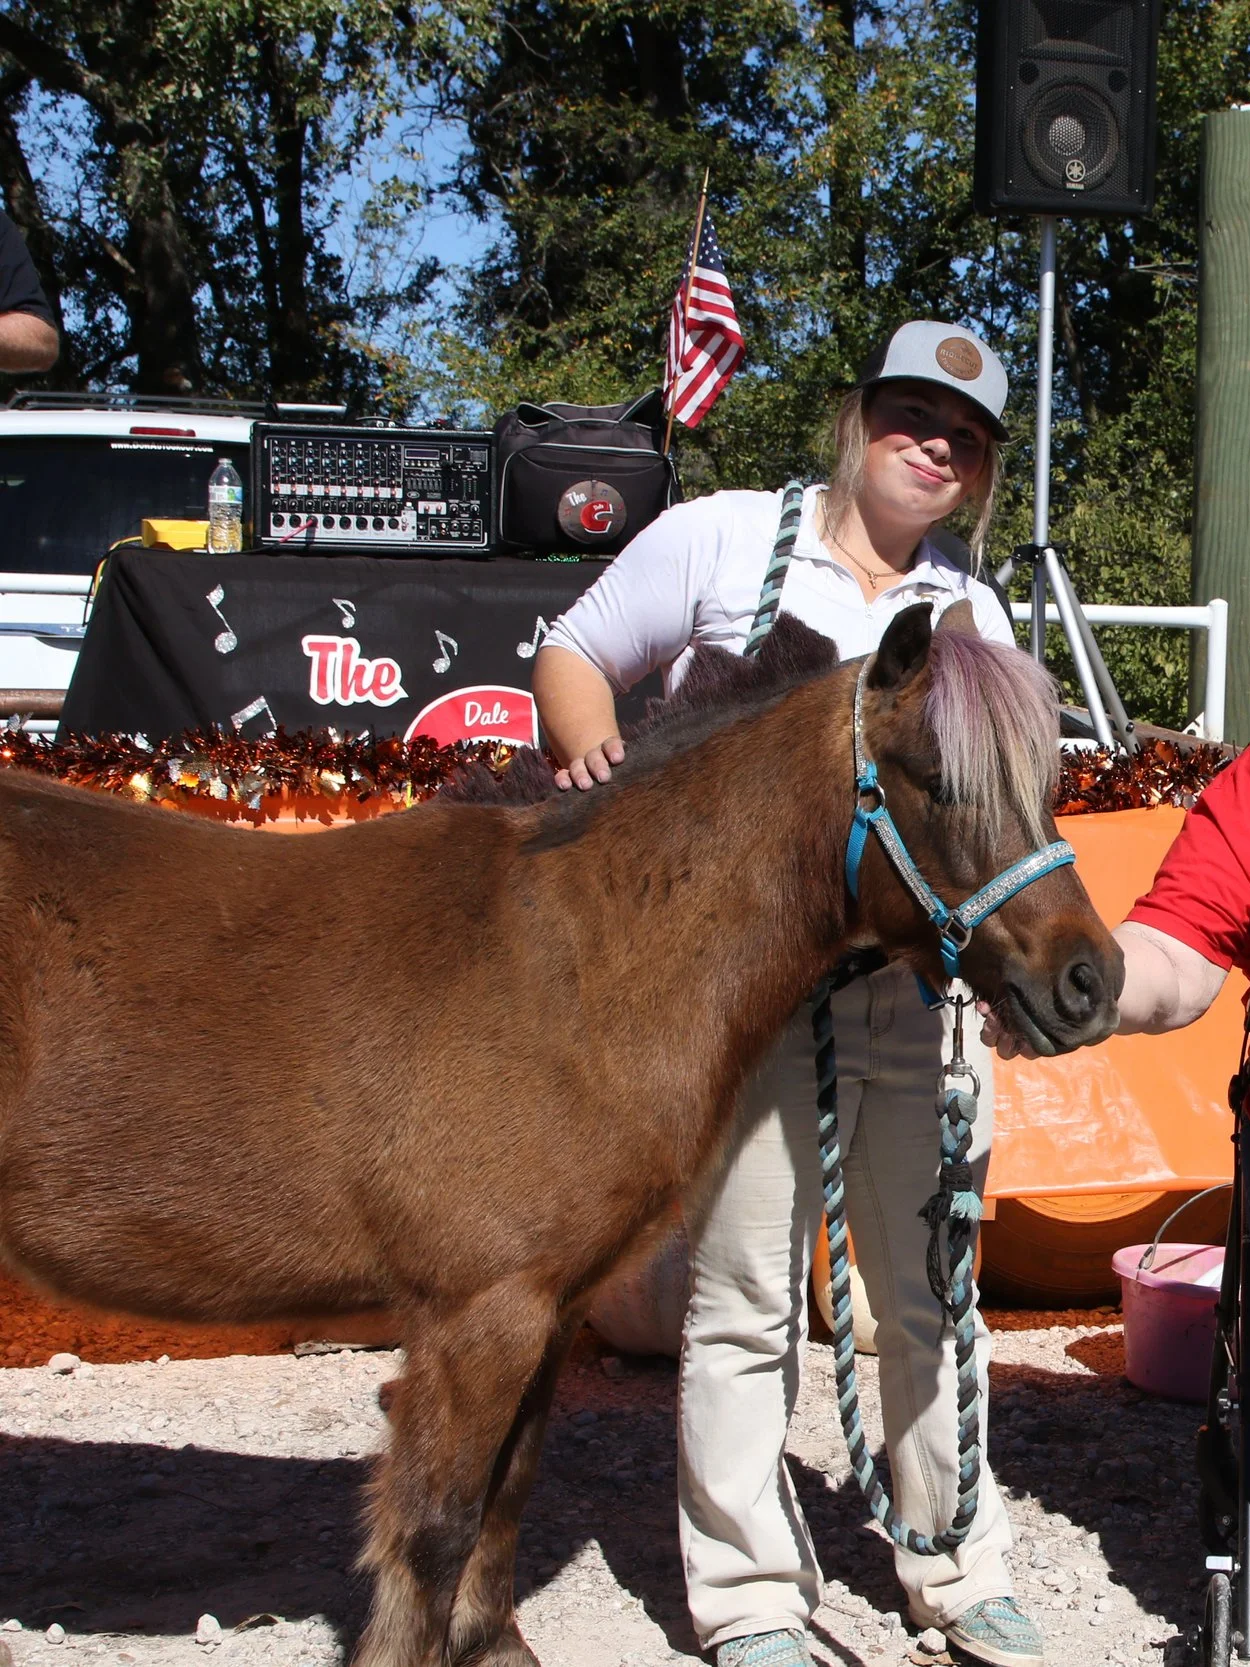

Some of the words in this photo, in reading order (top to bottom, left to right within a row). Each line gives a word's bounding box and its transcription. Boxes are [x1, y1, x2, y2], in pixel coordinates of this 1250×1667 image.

[565, 491, 587, 507] The
[304, 637, 403, 705] The
[464, 701, 510, 727] Dale
